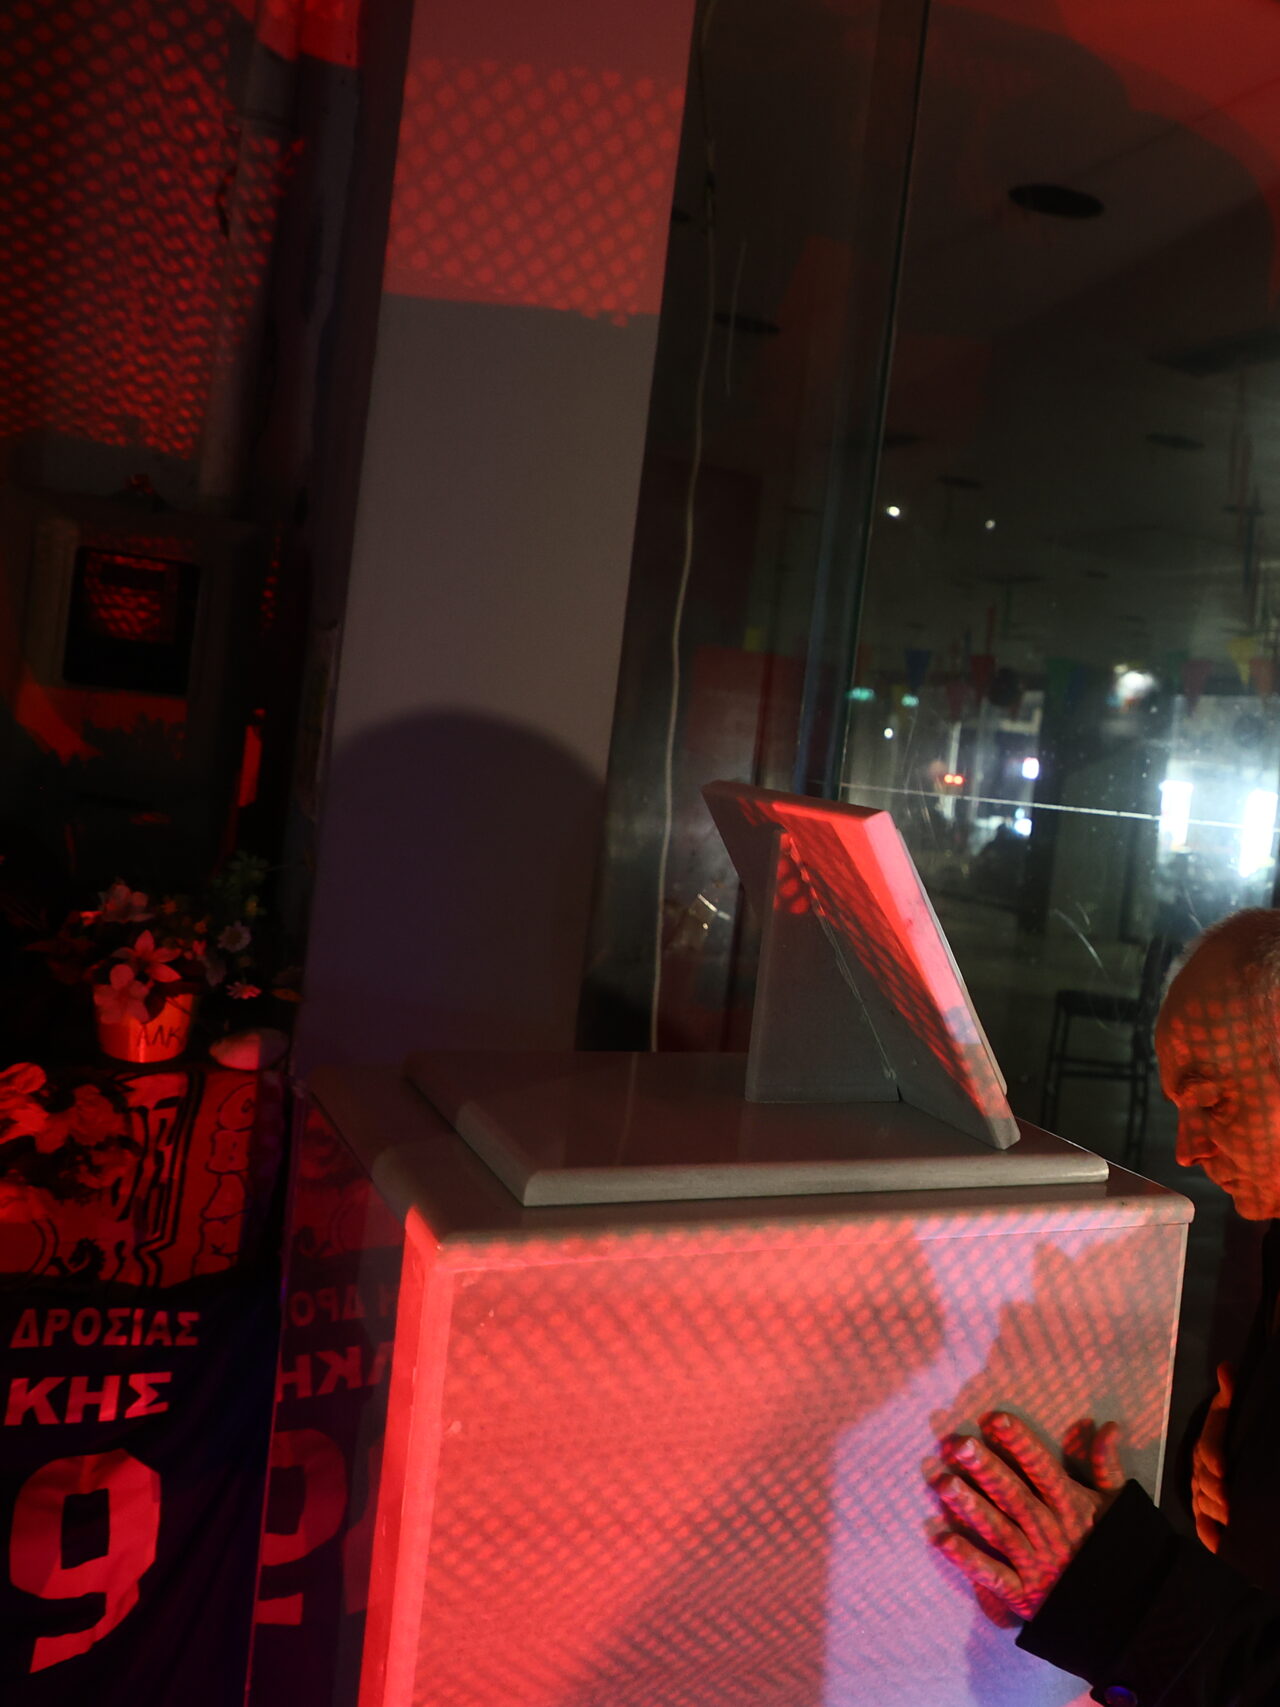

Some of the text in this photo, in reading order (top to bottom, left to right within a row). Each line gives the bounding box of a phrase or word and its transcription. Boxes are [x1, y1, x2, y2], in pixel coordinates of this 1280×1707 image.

[9, 1307, 201, 1349] ΔΡΟΣΙΑΣ
[3, 1372, 174, 1427] ΚΗΣ
[8, 1448, 164, 1675] 9
